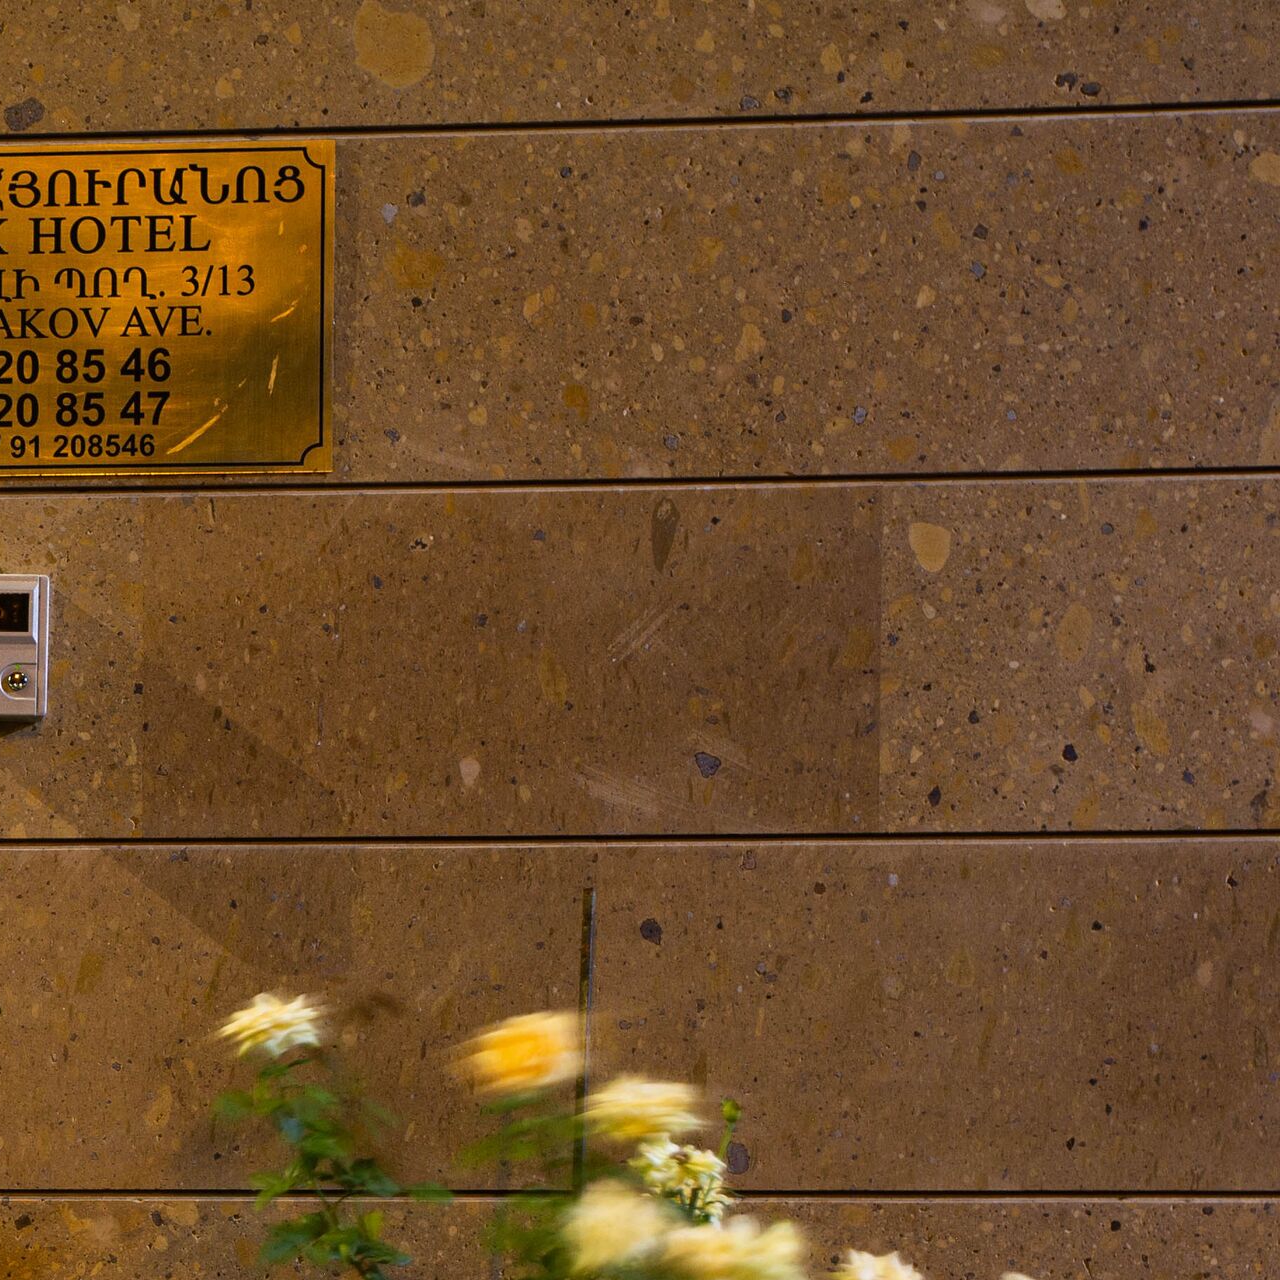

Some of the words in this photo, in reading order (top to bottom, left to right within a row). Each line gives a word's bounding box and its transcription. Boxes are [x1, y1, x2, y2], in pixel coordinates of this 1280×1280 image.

[28, 214, 212, 254] HOTEL
[54, 266, 166, 299] ՊՈՂ.
[180, 264, 256, 297] 3/13
[120, 305, 213, 338] AVE.
[55, 349, 107, 384] 85
[120, 347, 172, 383] 46
[55, 392, 107, 427] 85
[120, 391, 172, 426] 47
[10, 435, 41, 459] 91
[53, 434, 156, 457] 208546
